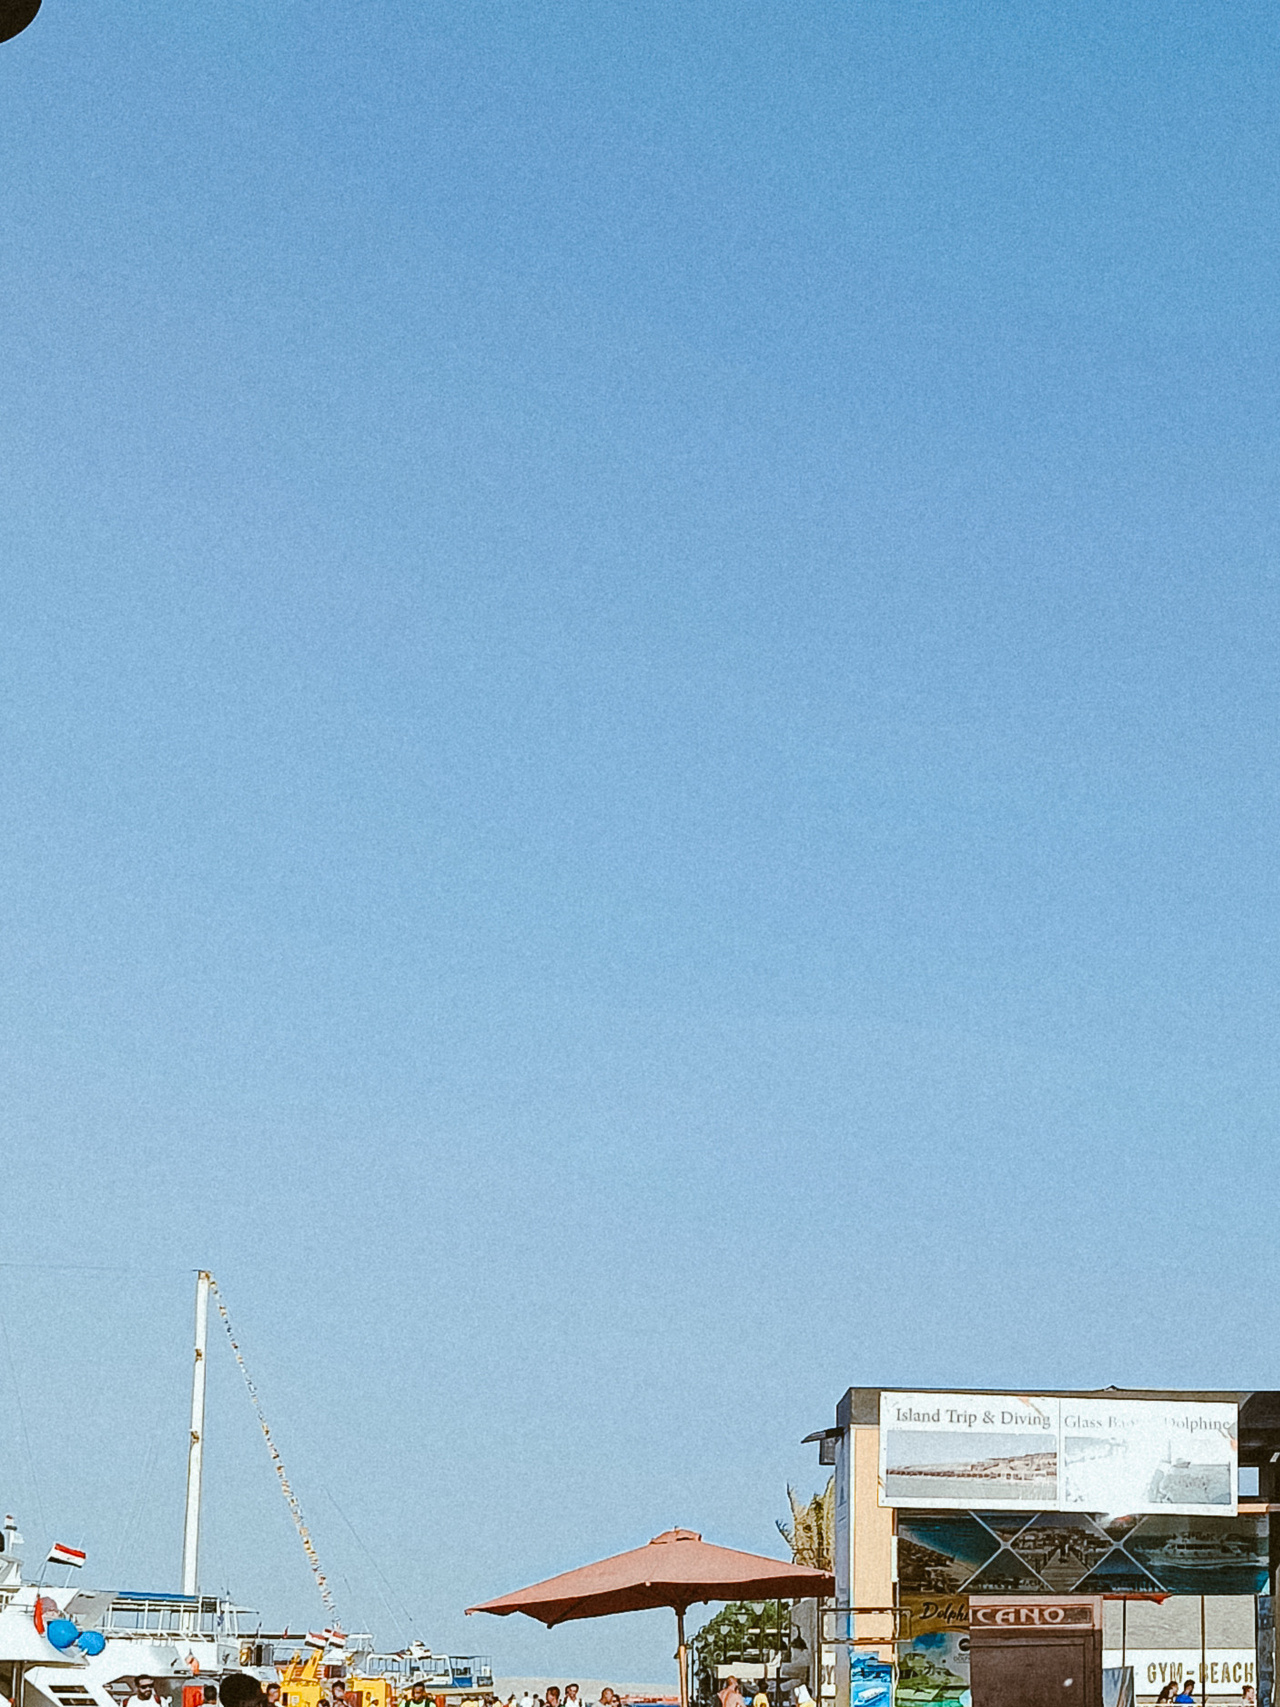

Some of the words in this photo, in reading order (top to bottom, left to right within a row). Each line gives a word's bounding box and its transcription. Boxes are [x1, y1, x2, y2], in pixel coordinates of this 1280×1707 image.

[896, 1408, 941, 1423] Island
[946, 1409, 978, 1428] Trip
[982, 1411, 995, 1424] &
[1001, 1411, 1052, 1430] Diving
[1064, 1415, 1103, 1429] Glass
